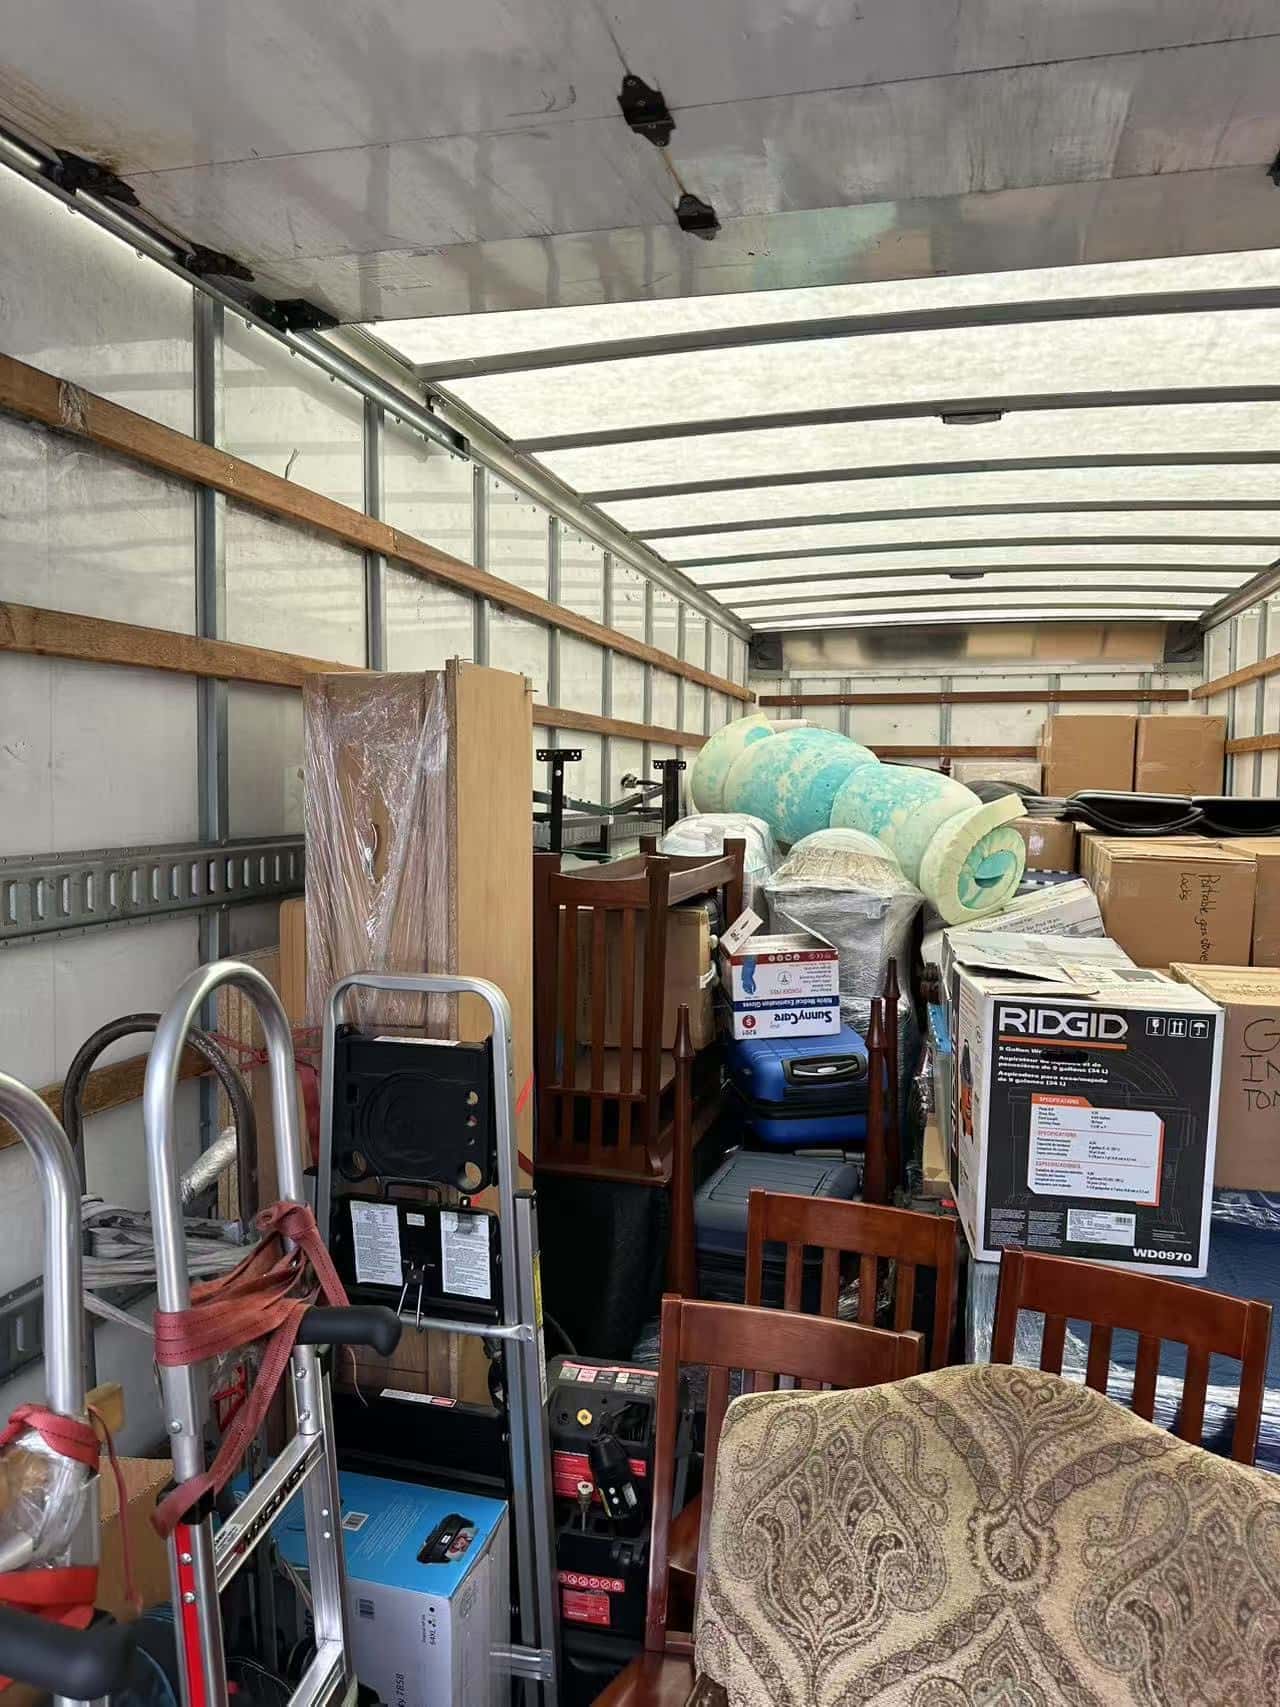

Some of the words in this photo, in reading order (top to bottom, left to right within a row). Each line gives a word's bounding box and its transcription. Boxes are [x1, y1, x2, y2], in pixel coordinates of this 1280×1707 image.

[761, 999, 795, 1007] Examination
[774, 1009, 832, 1024] SunnyCare
[999, 1006, 1129, 1040] RIDGID
[1132, 1247, 1192, 1262] WD0970
